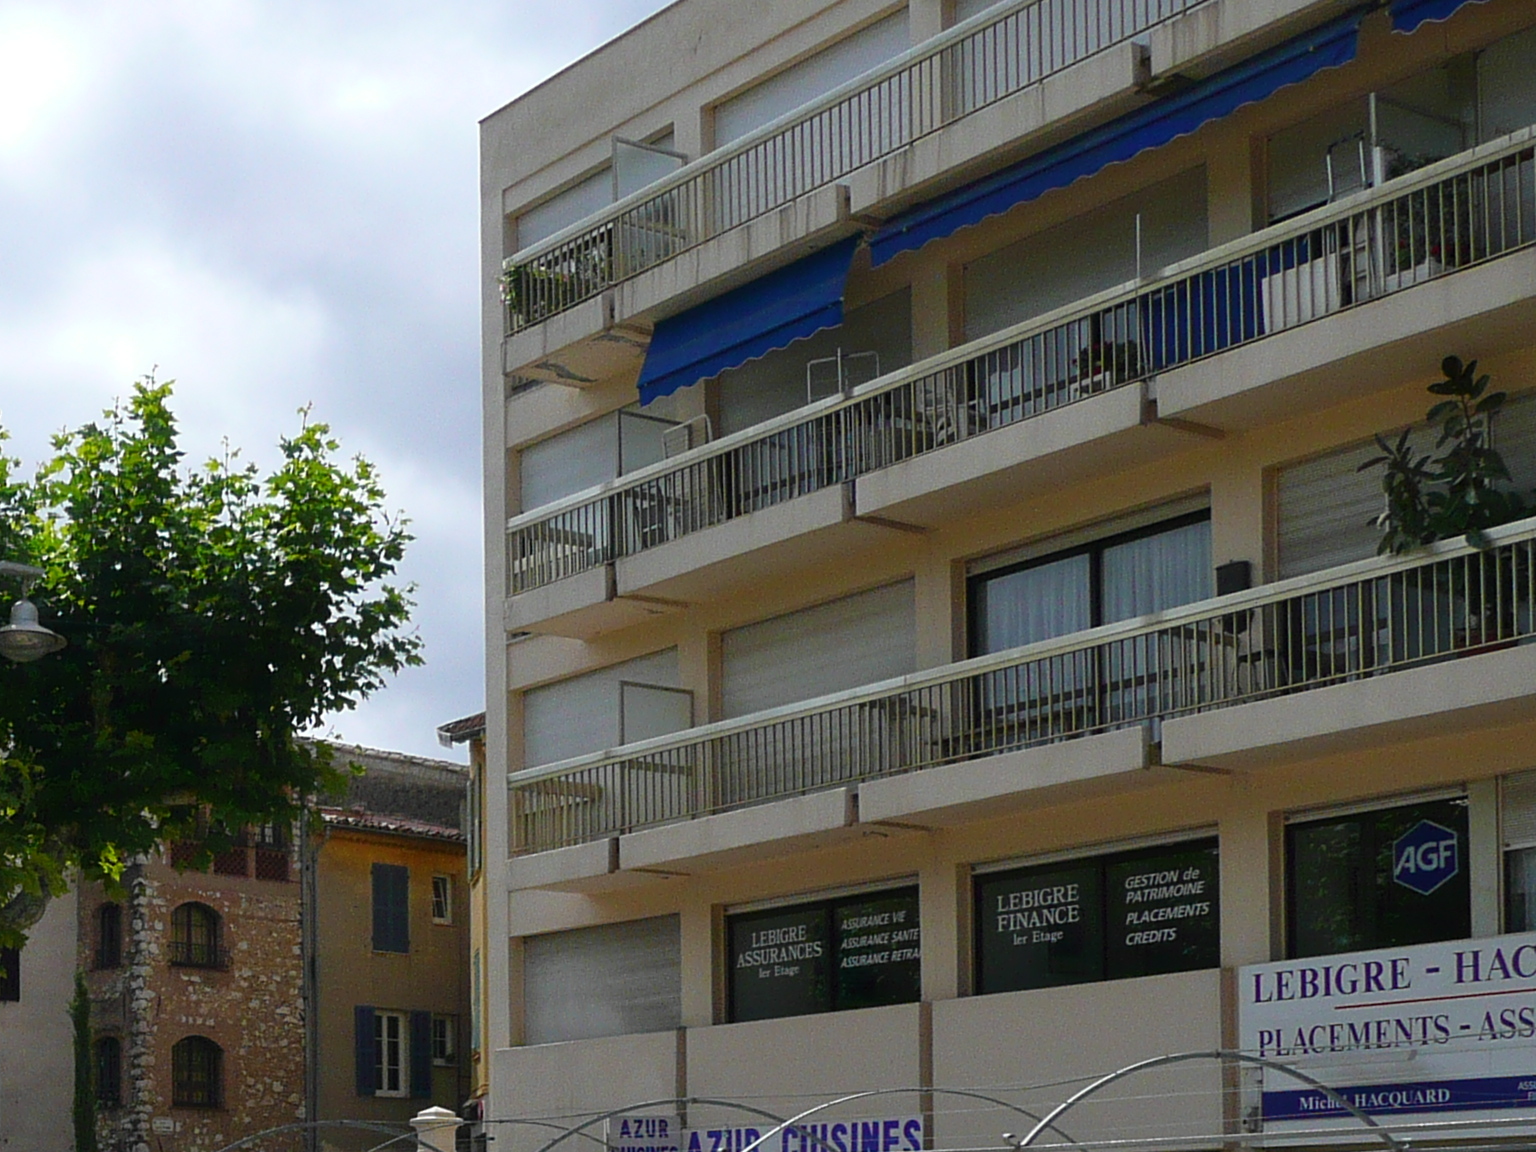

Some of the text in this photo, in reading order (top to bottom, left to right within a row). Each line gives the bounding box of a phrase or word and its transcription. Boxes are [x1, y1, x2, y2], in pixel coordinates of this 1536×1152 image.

[1395, 840, 1456, 876] AGF
[1125, 866, 1200, 889] GESTION de
[996, 884, 1080, 912] LEBIGRE
[1126, 880, 1206, 904] PATRIMOINE
[840, 910, 907, 931] ASSURANCE VIE
[996, 904, 1080, 932] FINANCE
[1126, 902, 1210, 925] PLACEMENTS
[752, 925, 807, 948] LEBIGRE
[840, 928, 919, 950] ASSURANCE SANTE
[1032, 929, 1064, 943] Etage
[1125, 927, 1177, 946] CREDITS
[737, 941, 823, 968] ASSURANCES
[840, 951, 890, 968] ASSURANCE
[774, 964, 800, 978] Etage
[1253, 957, 1412, 1003] LEBIGRE
[1454, 945, 1536, 984] HAC
[1258, 1014, 1451, 1058] PLACEMENTS
[1299, 1088, 1451, 1110] Miche HACQUARD
[620, 1119, 669, 1138] AZUR
